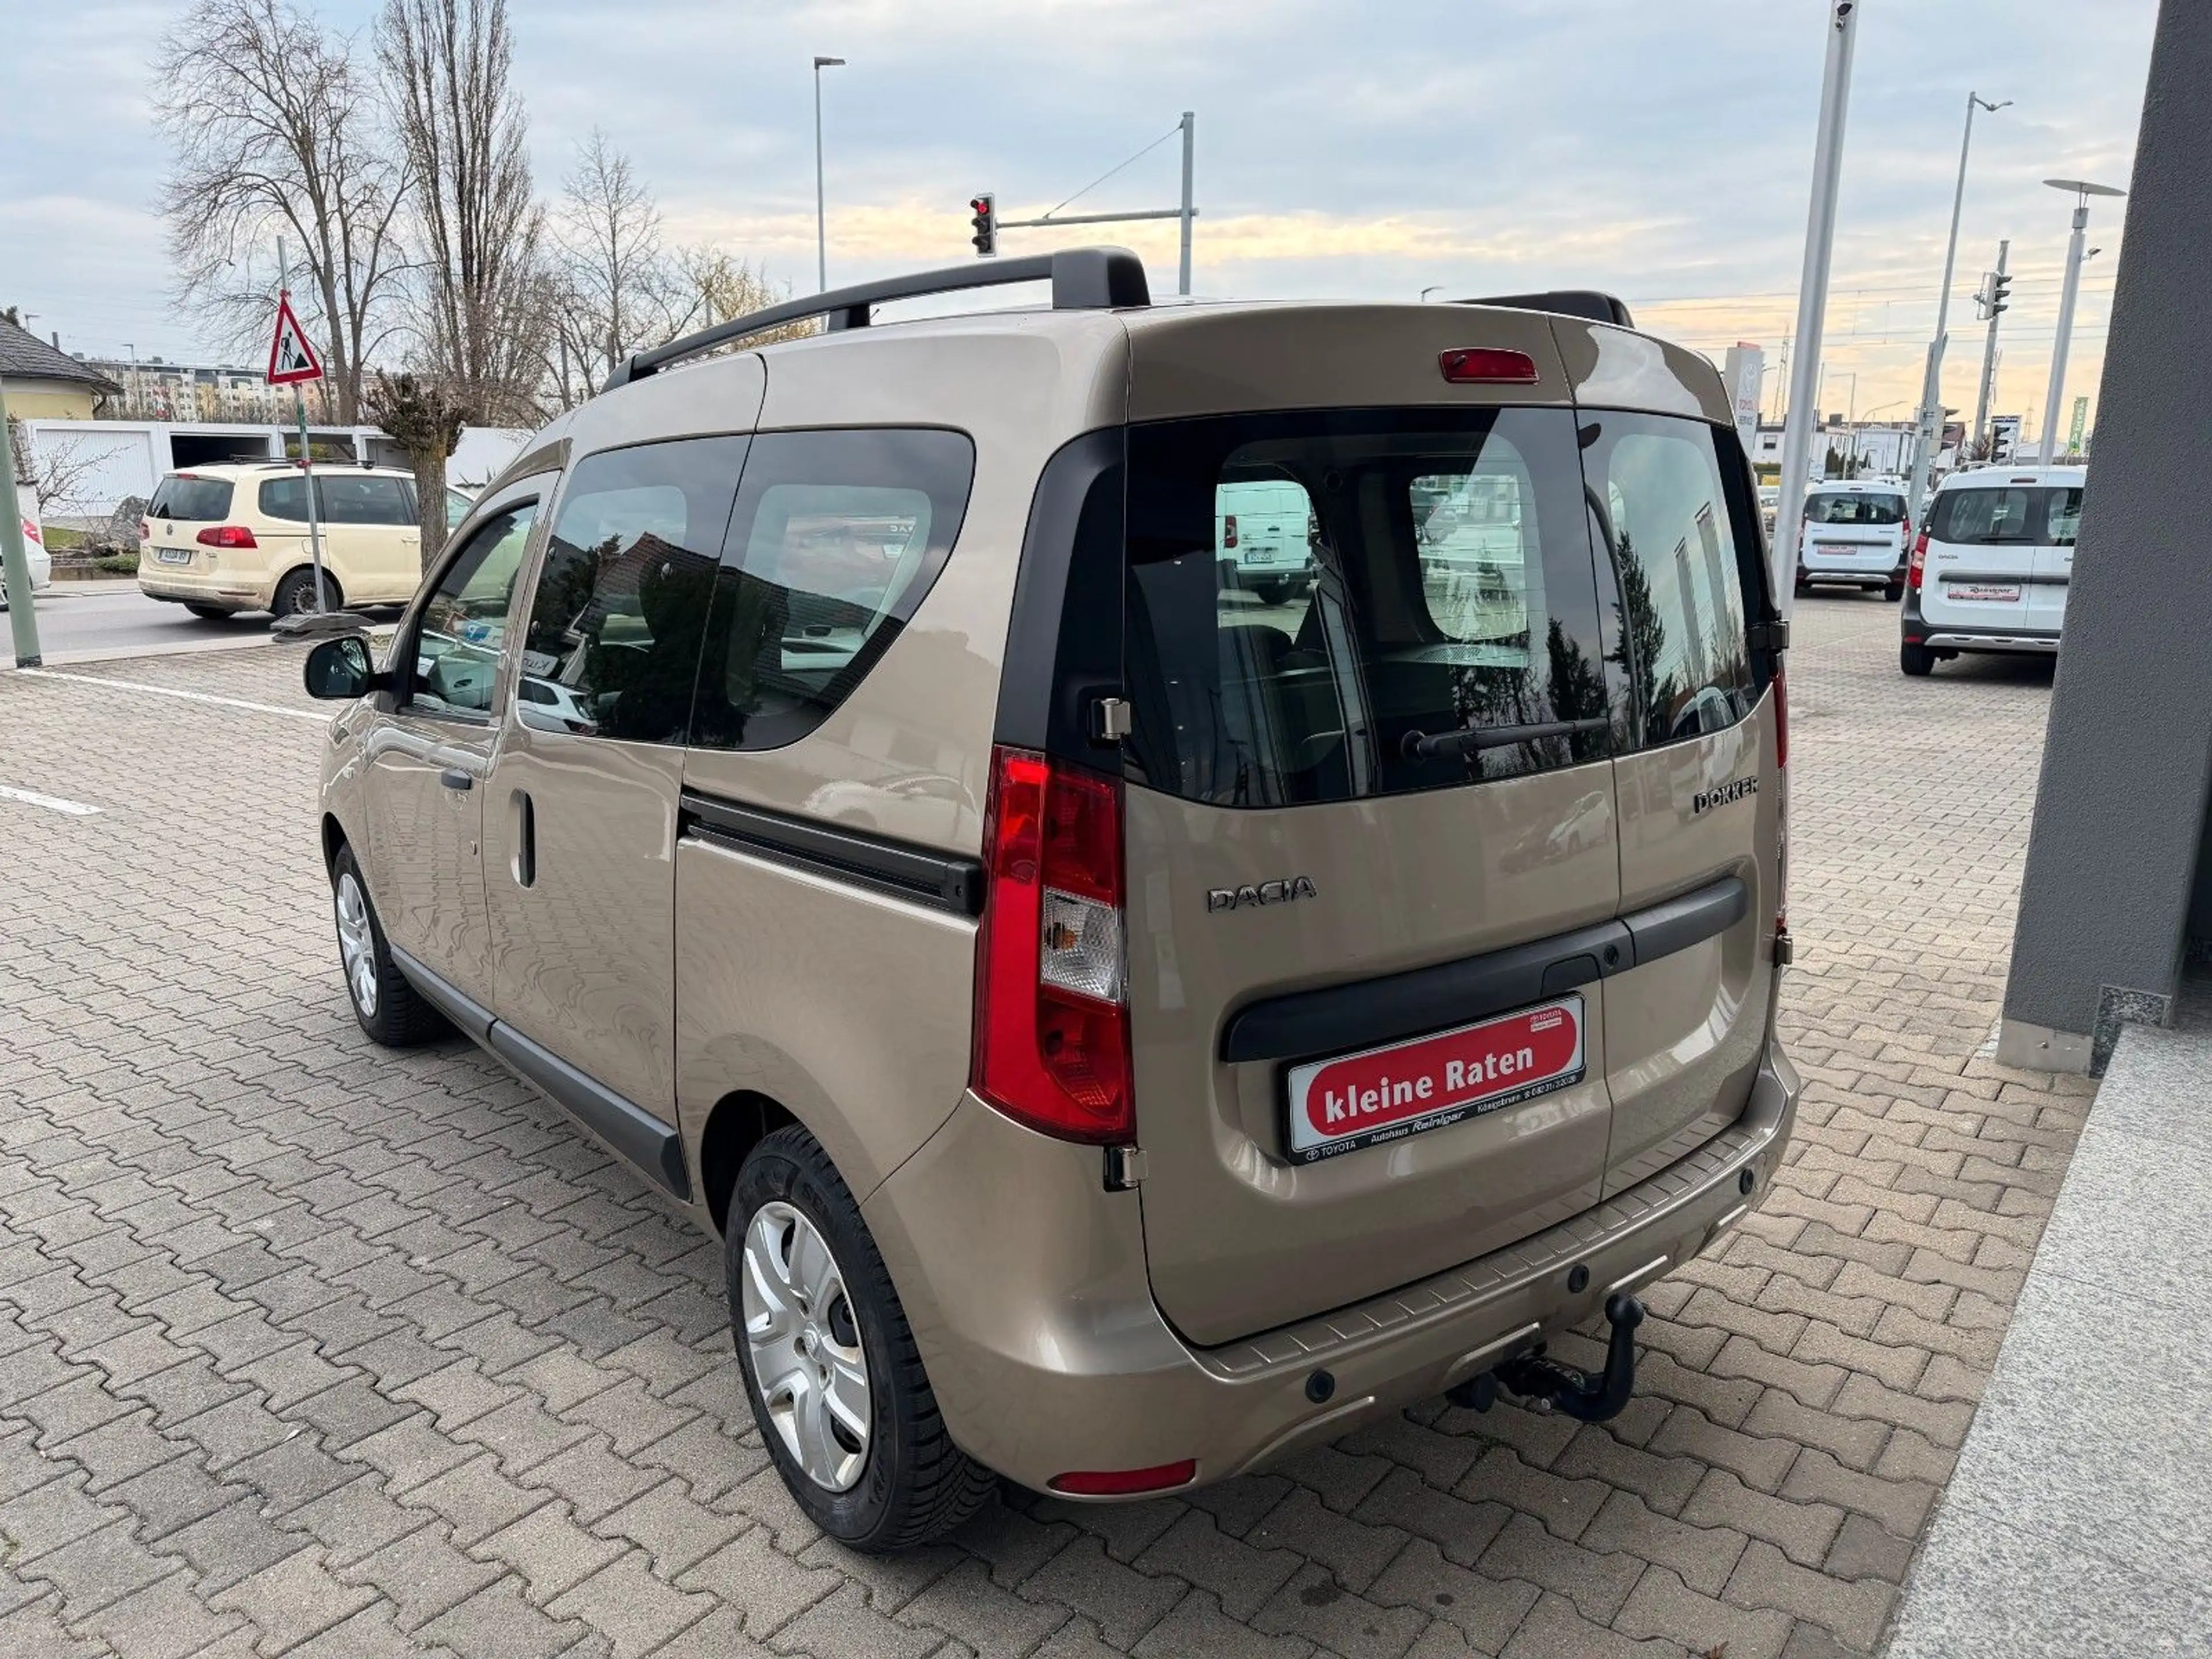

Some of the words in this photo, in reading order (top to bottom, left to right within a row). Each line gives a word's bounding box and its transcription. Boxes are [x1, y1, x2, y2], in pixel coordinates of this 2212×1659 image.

[1694, 775, 1759, 814] DOKKER
[1207, 876, 1317, 913] DACIA
[1325, 1077, 1433, 1123] kleine
[1445, 1046, 1533, 1092] Raten
[1321, 1140, 1357, 1157] TOYOTA
[1370, 1127, 1409, 1143] Autohaus
